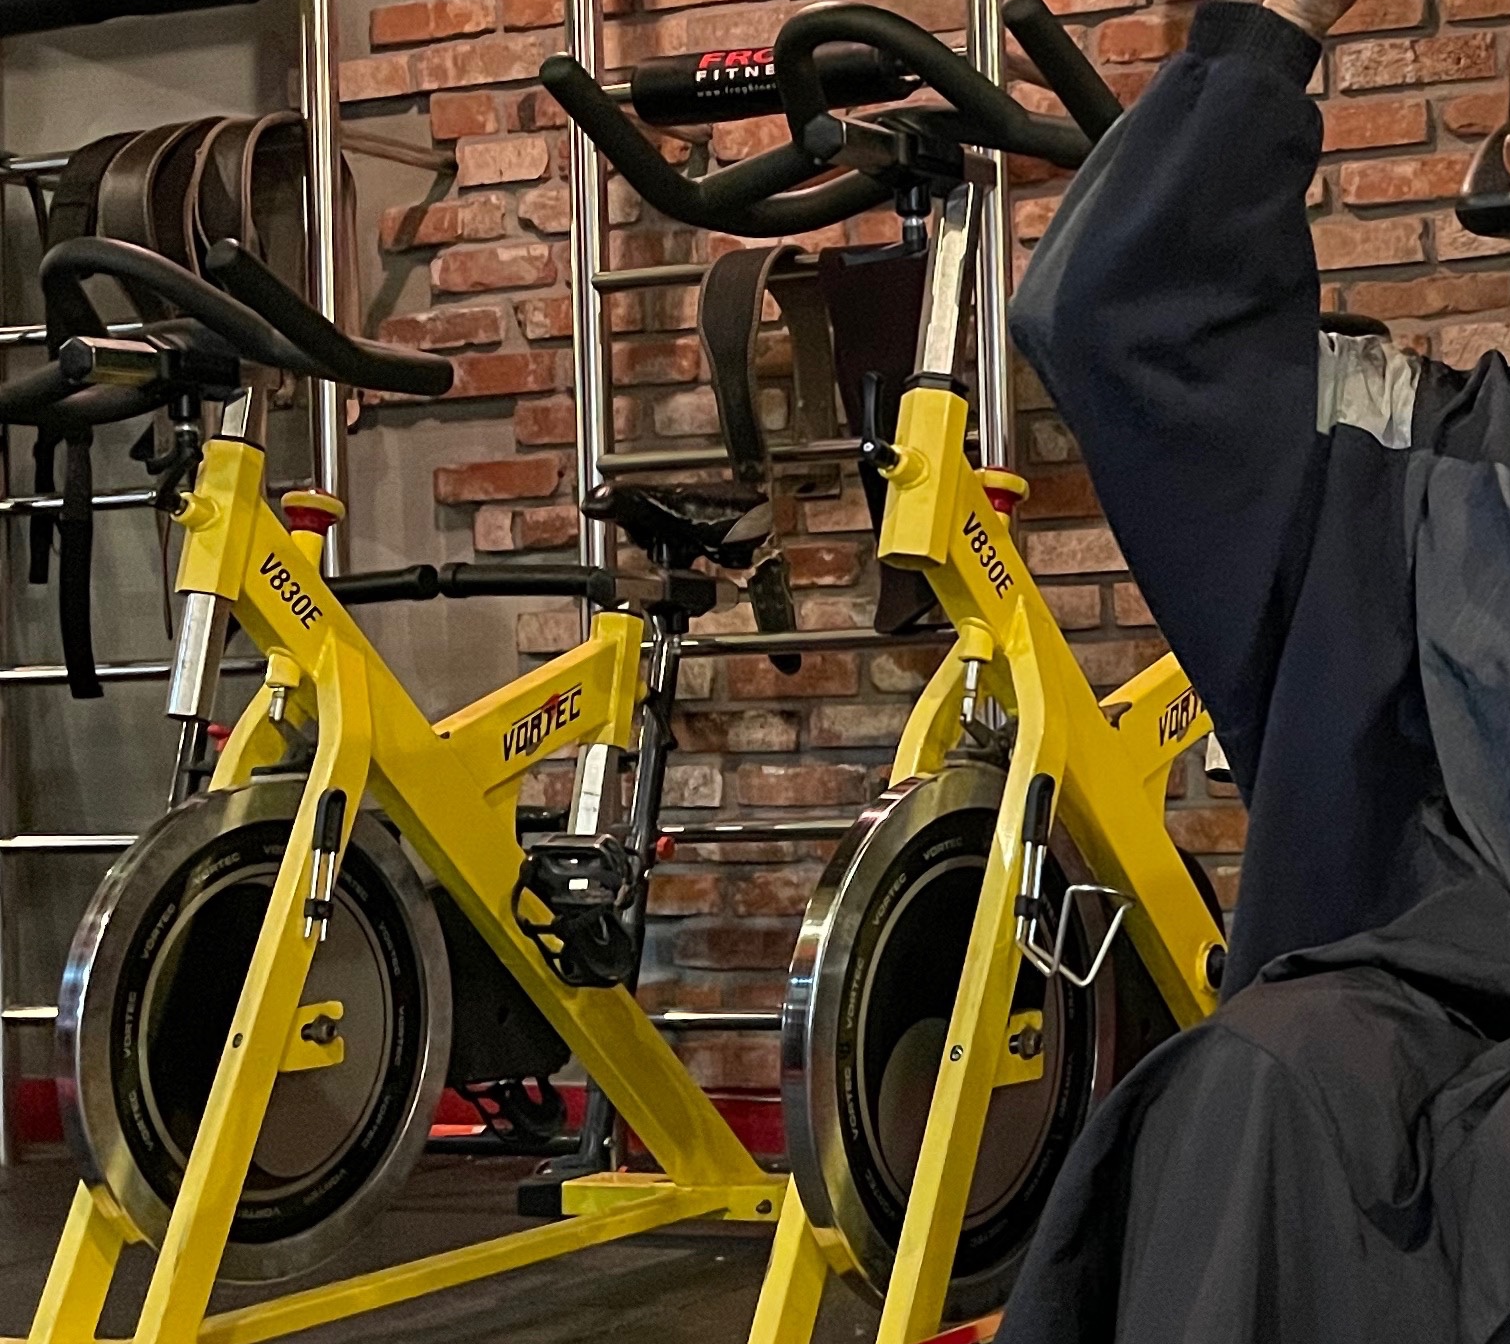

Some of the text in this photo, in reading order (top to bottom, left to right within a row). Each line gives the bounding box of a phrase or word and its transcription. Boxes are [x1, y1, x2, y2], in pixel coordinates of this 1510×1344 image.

[695, 63, 776, 83] FITNE
[698, 47, 774, 69] FRO
[963, 510, 1014, 600] V830E
[260, 552, 323, 630] V830E
[503, 687, 582, 762] VORTEC
[1158, 689, 1205, 748] VORT
[141, 902, 176, 960] VORTEC
[871, 872, 908, 927] VORTEC
[123, 992, 137, 1059] VORTEC
[846, 956, 865, 1029] VORTEC
[844, 1065, 860, 1142] VORTEC
